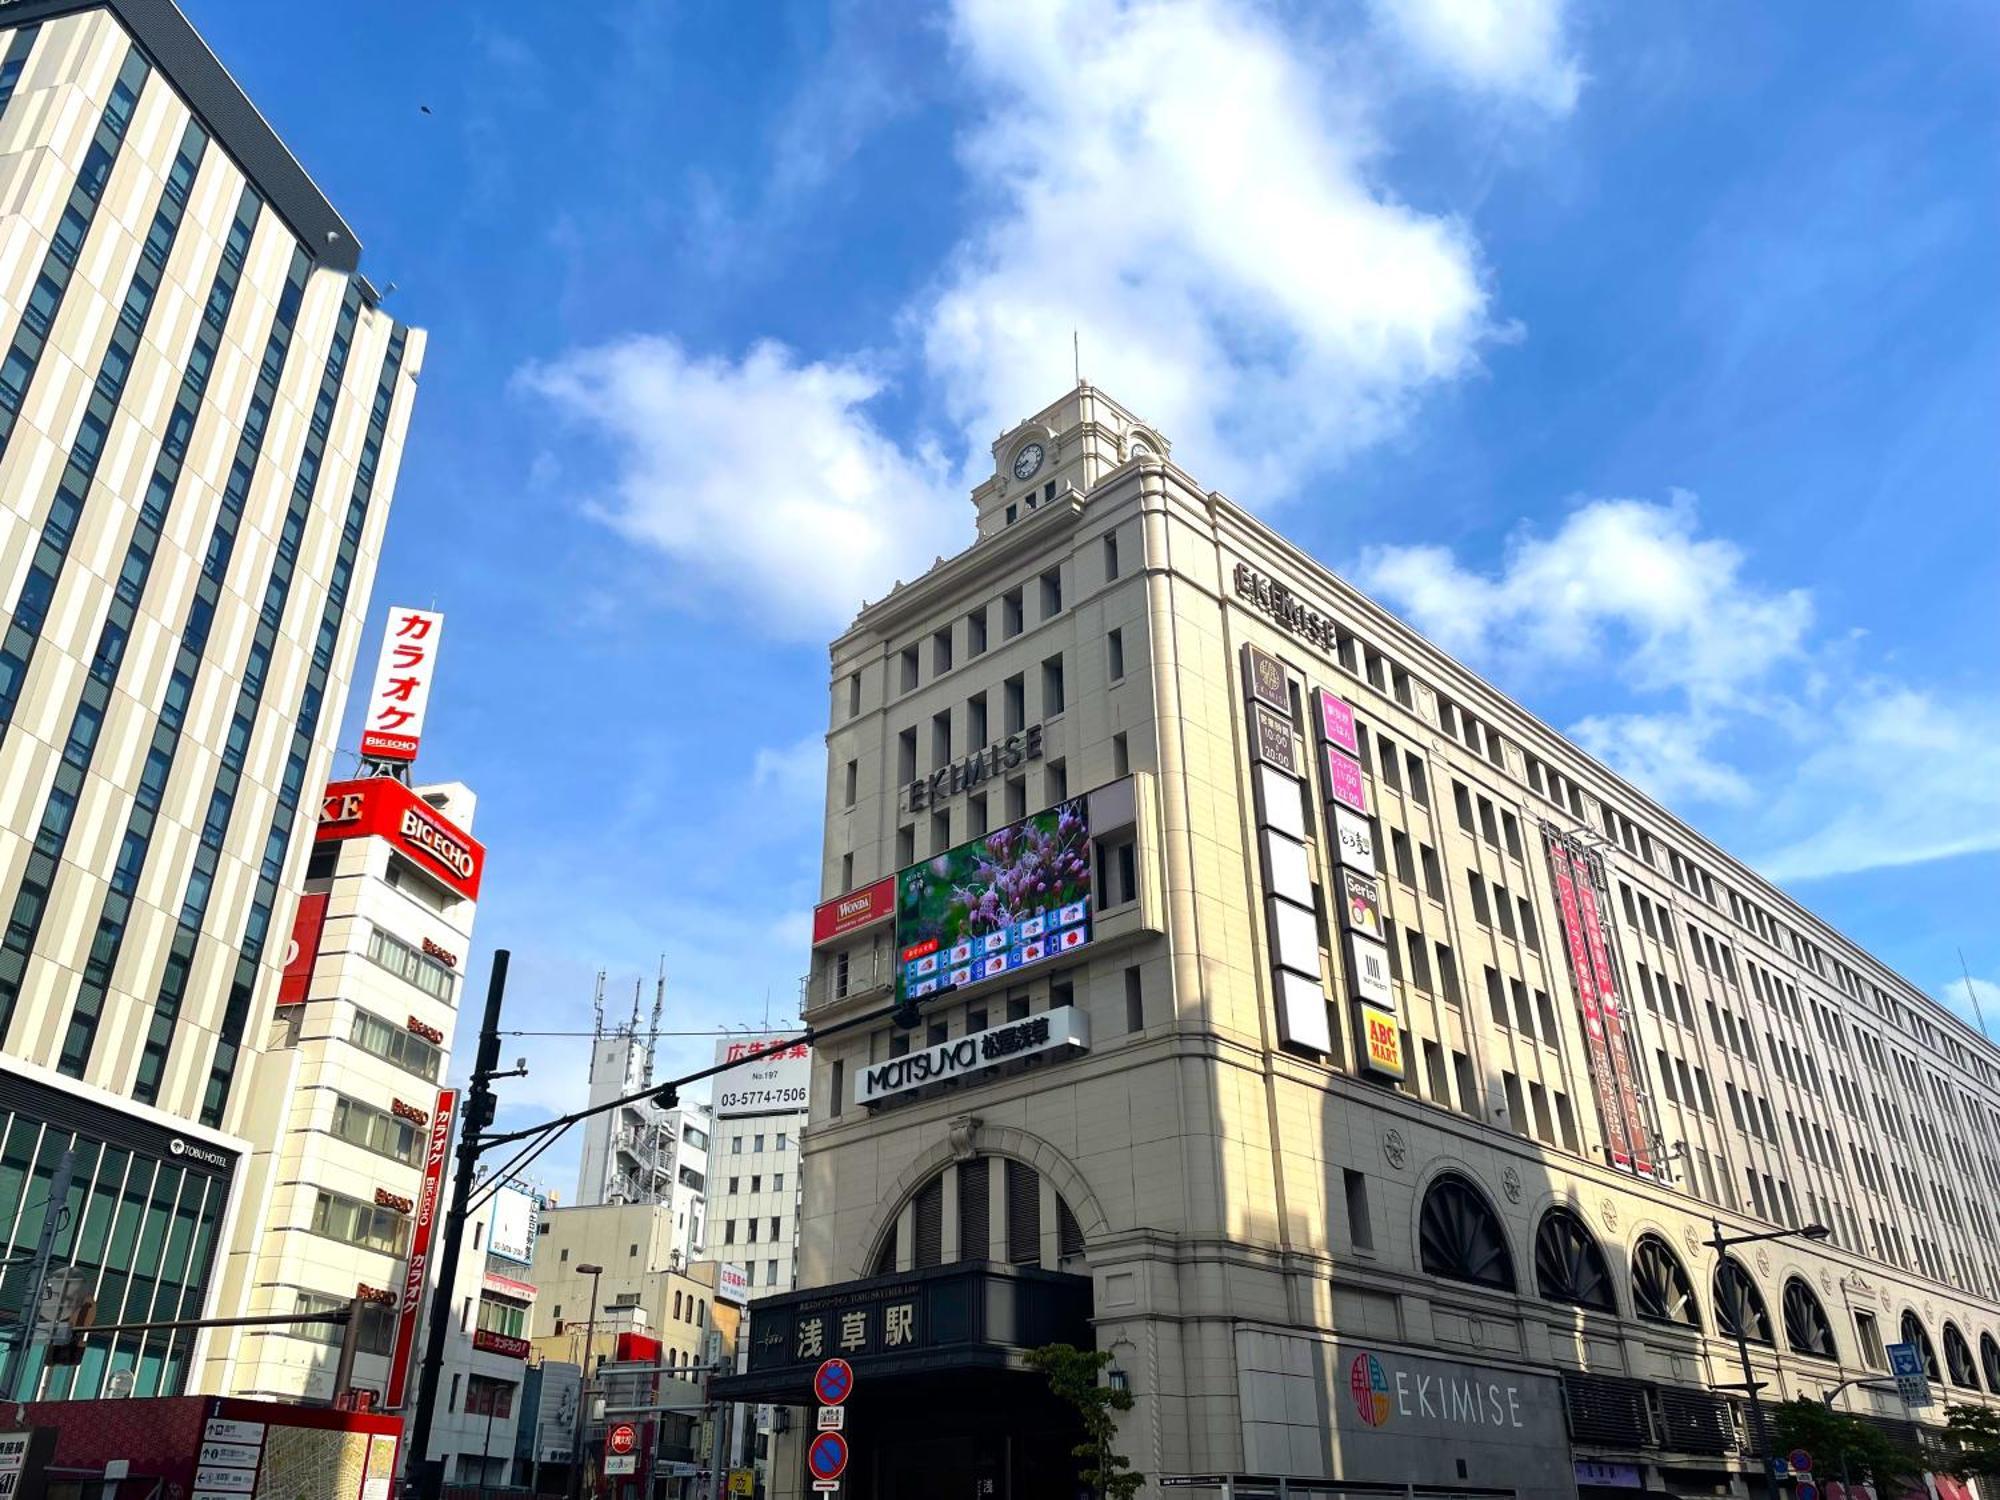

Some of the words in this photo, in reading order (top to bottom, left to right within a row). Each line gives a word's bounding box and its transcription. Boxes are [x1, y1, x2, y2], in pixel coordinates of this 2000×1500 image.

[1233, 562, 1337, 652] EKIMISE
[377, 615, 432, 730] カラオケ
[1264, 727, 1288, 748] 10:00
[1264, 745, 1289, 768] 20:00
[908, 723, 1043, 813] EKIMISE
[1347, 879, 1377, 902] Seria
[981, 1016, 1050, 1061] 松屋浅草
[1370, 1020, 1396, 1049] ABC
[1371, 1042, 1398, 1065] MART
[721, 1087, 807, 1107] 03-5774-7506
[184, 1145, 205, 1160] TOBU
[204, 1152, 227, 1167] HOTEL
[429, 1111, 450, 1166] カラオケ
[403, 1254, 426, 1315] カラオケ
[797, 1304, 913, 1358] 浅草駅
[1395, 1371, 1523, 1428] EKIMISE
